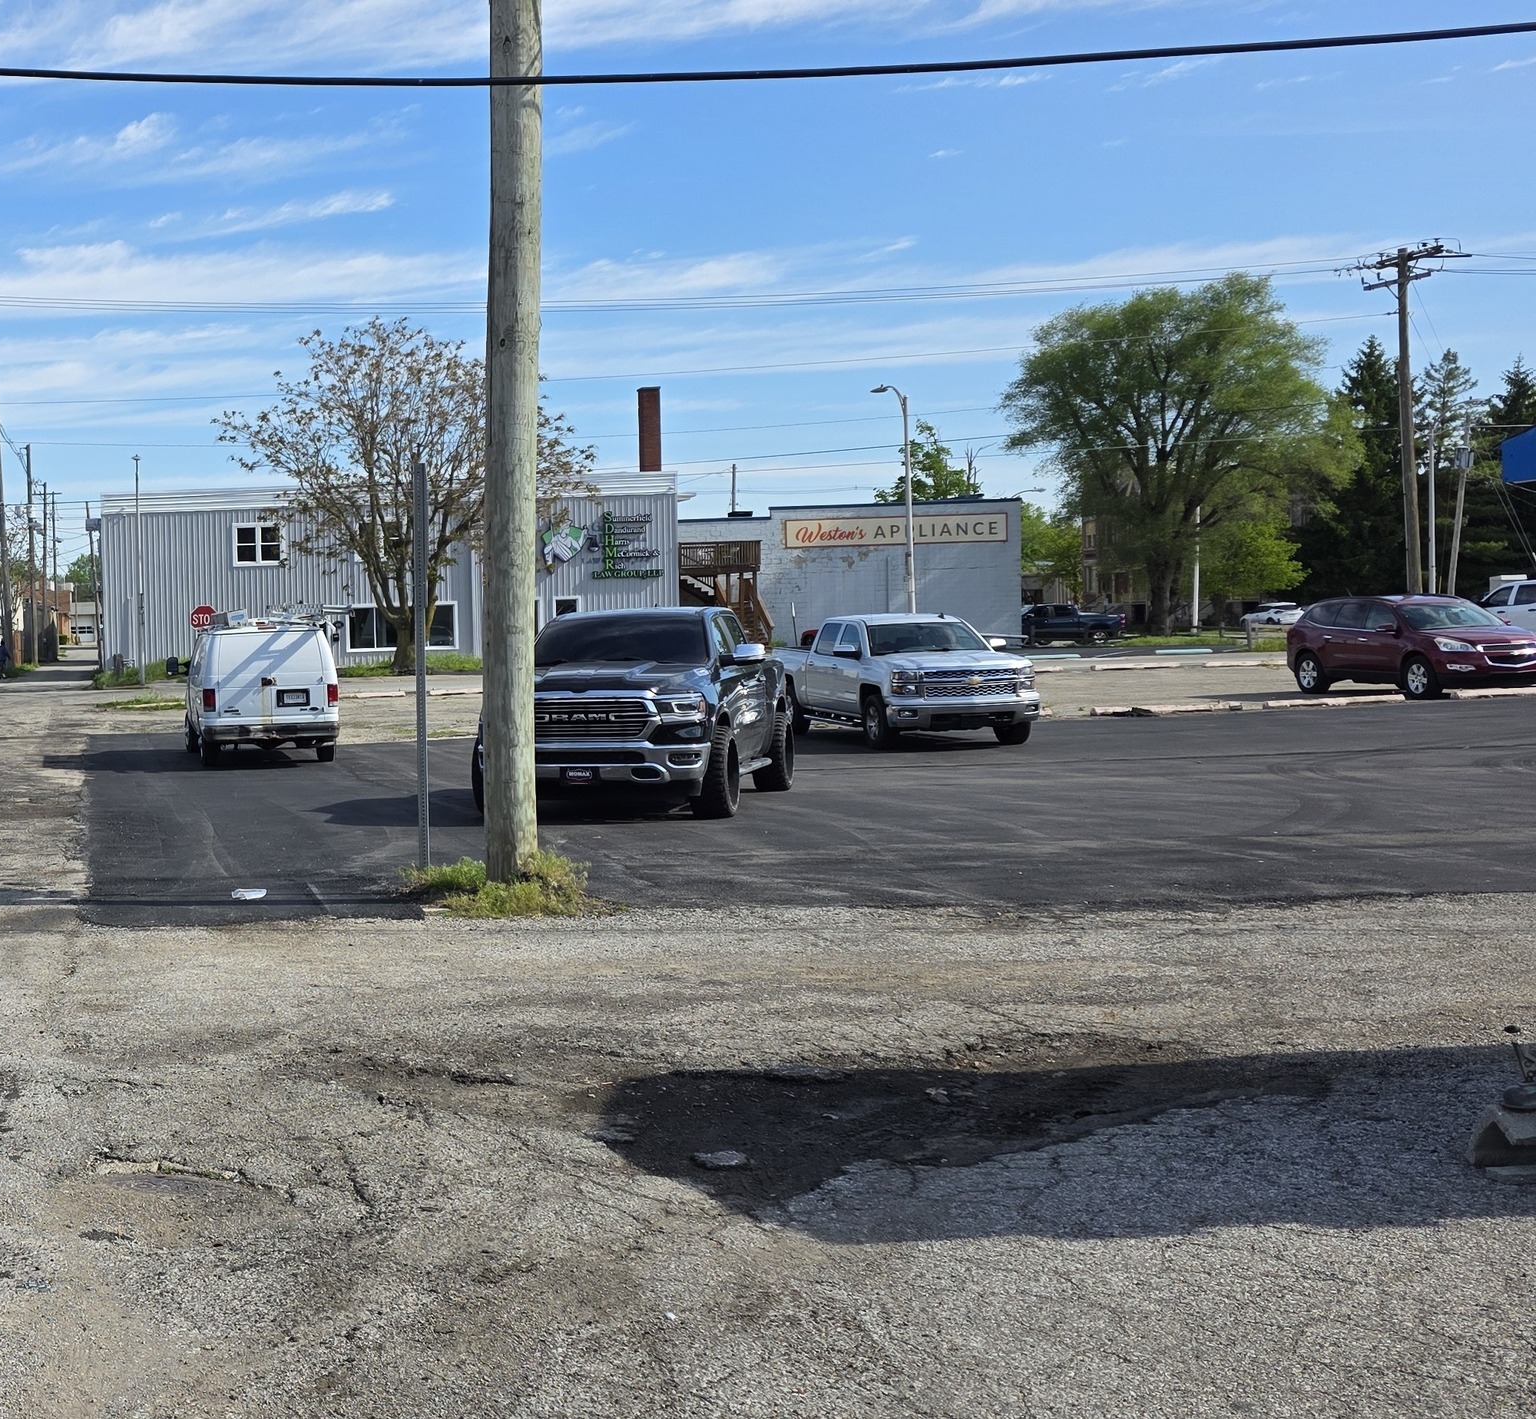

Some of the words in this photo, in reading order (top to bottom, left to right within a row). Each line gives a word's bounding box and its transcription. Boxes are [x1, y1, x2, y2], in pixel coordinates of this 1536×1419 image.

[604, 511, 653, 522] Summerfield
[605, 523, 646, 534] Dandurand
[796, 522, 866, 543] Weston's
[605, 535, 631, 546] Harris
[605, 547, 651, 558] McCormick
[652, 549, 661, 557] &
[606, 559, 626, 570] Rich
[192, 614, 211, 625] STO
[551, 713, 607, 721] RAM
